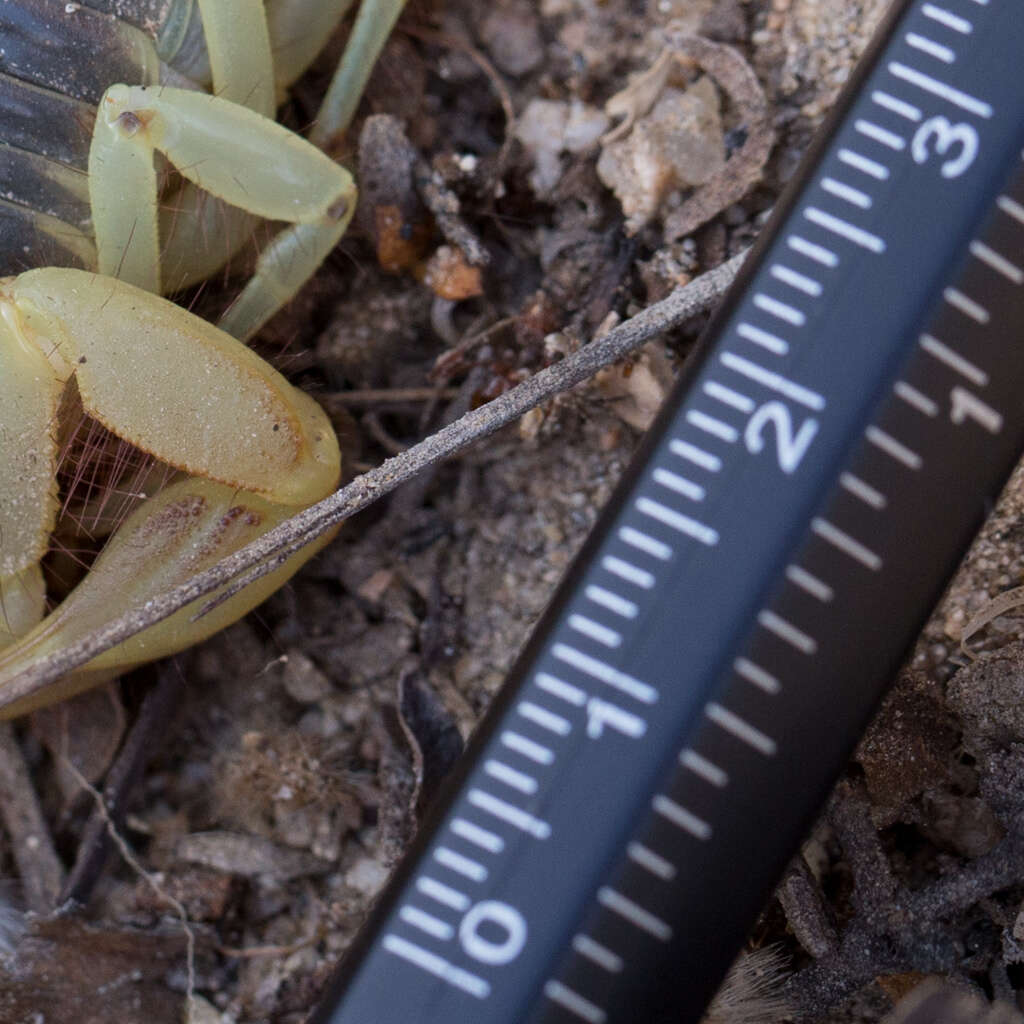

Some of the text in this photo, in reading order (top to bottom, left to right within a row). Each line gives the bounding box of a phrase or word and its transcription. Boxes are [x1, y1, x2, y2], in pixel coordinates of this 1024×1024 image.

[911, 115, 980, 179] 3
[745, 401, 819, 474] 2
[950, 385, 1004, 435] 1
[587, 696, 648, 741] 1
[458, 899, 527, 966] 0
